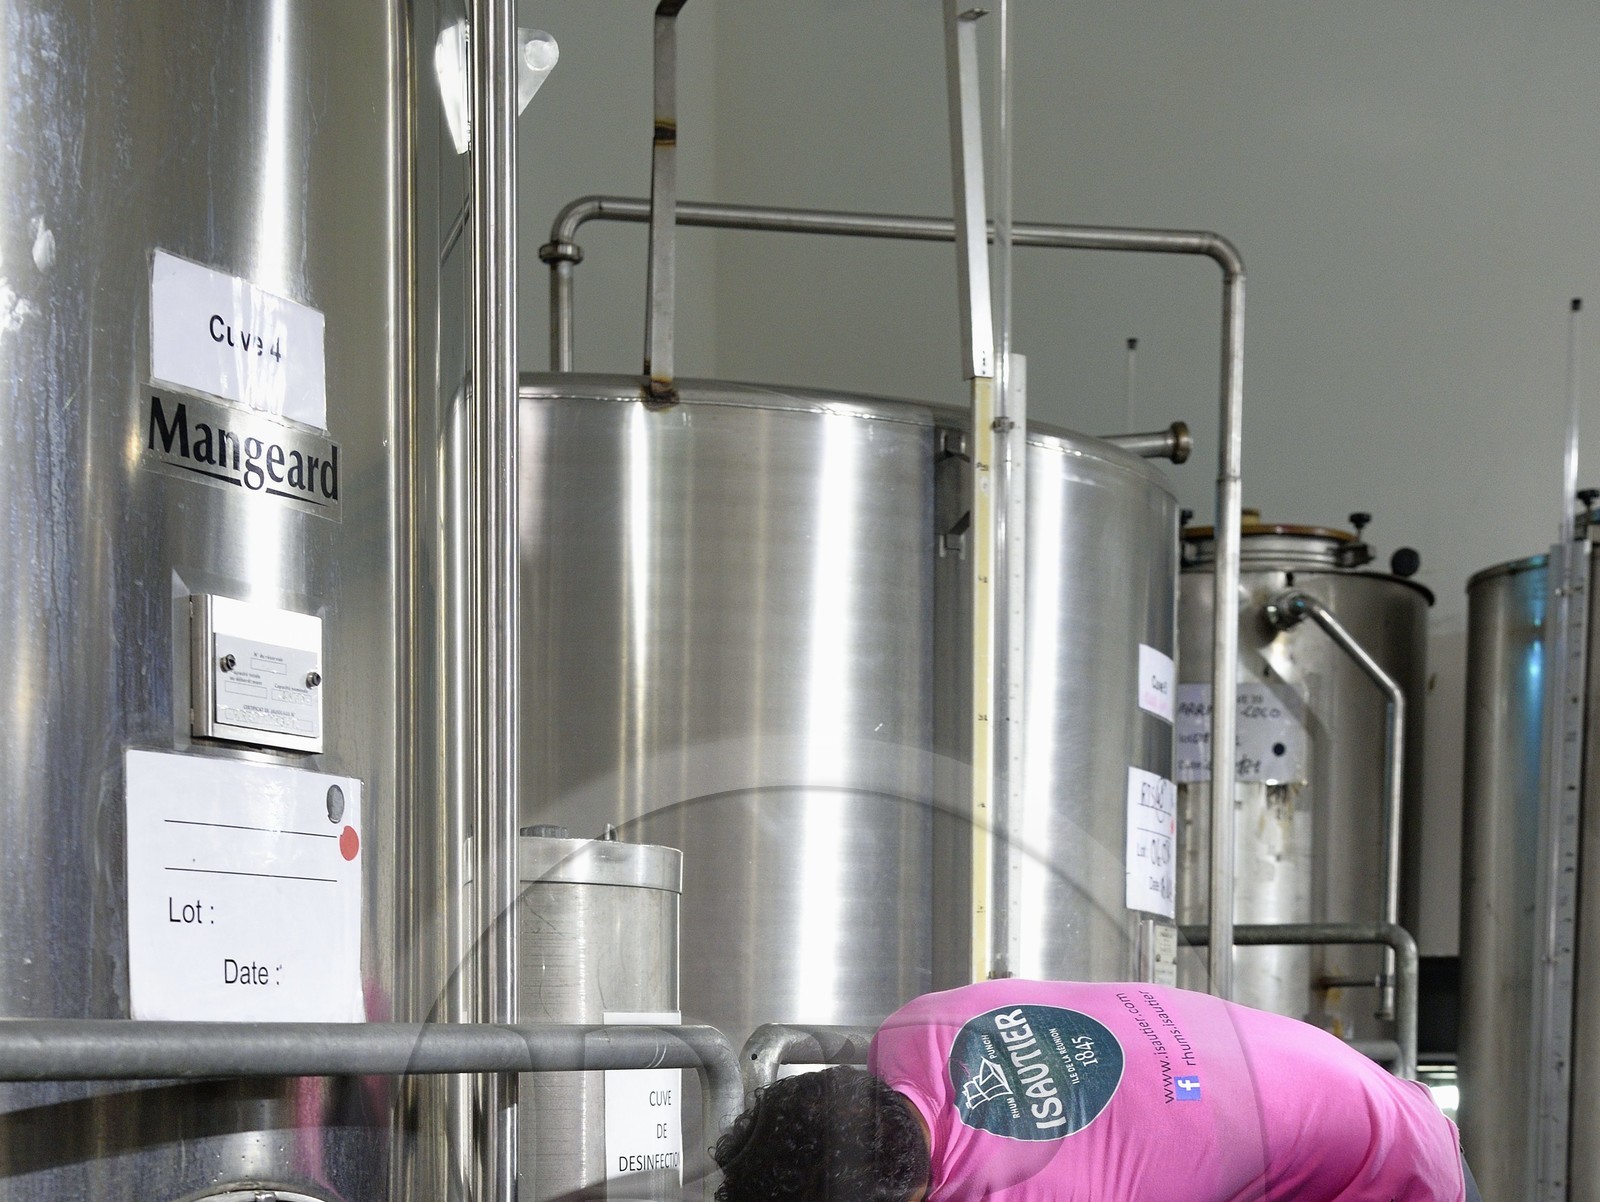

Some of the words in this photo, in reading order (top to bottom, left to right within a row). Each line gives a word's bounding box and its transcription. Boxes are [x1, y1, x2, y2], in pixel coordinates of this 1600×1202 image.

[270, 336, 282, 363] 4
[147, 395, 339, 501] Mangeard
[169, 896, 203, 924] Lot
[224, 958, 269, 985] Date
[1138, 990, 1197, 1066] rhums.isautier
[981, 1033, 998, 1060] PUNCH
[1061, 1054, 1070, 1064] LA
[1070, 1036, 1099, 1067] 1845
[1115, 992, 1175, 1104] www.isautier.com
[994, 1008, 1067, 1129] ISAUTIER
[649, 1090, 672, 1107] CUVE
[1006, 1096, 1021, 1119] RHUM
[656, 1122, 668, 1139] DE
